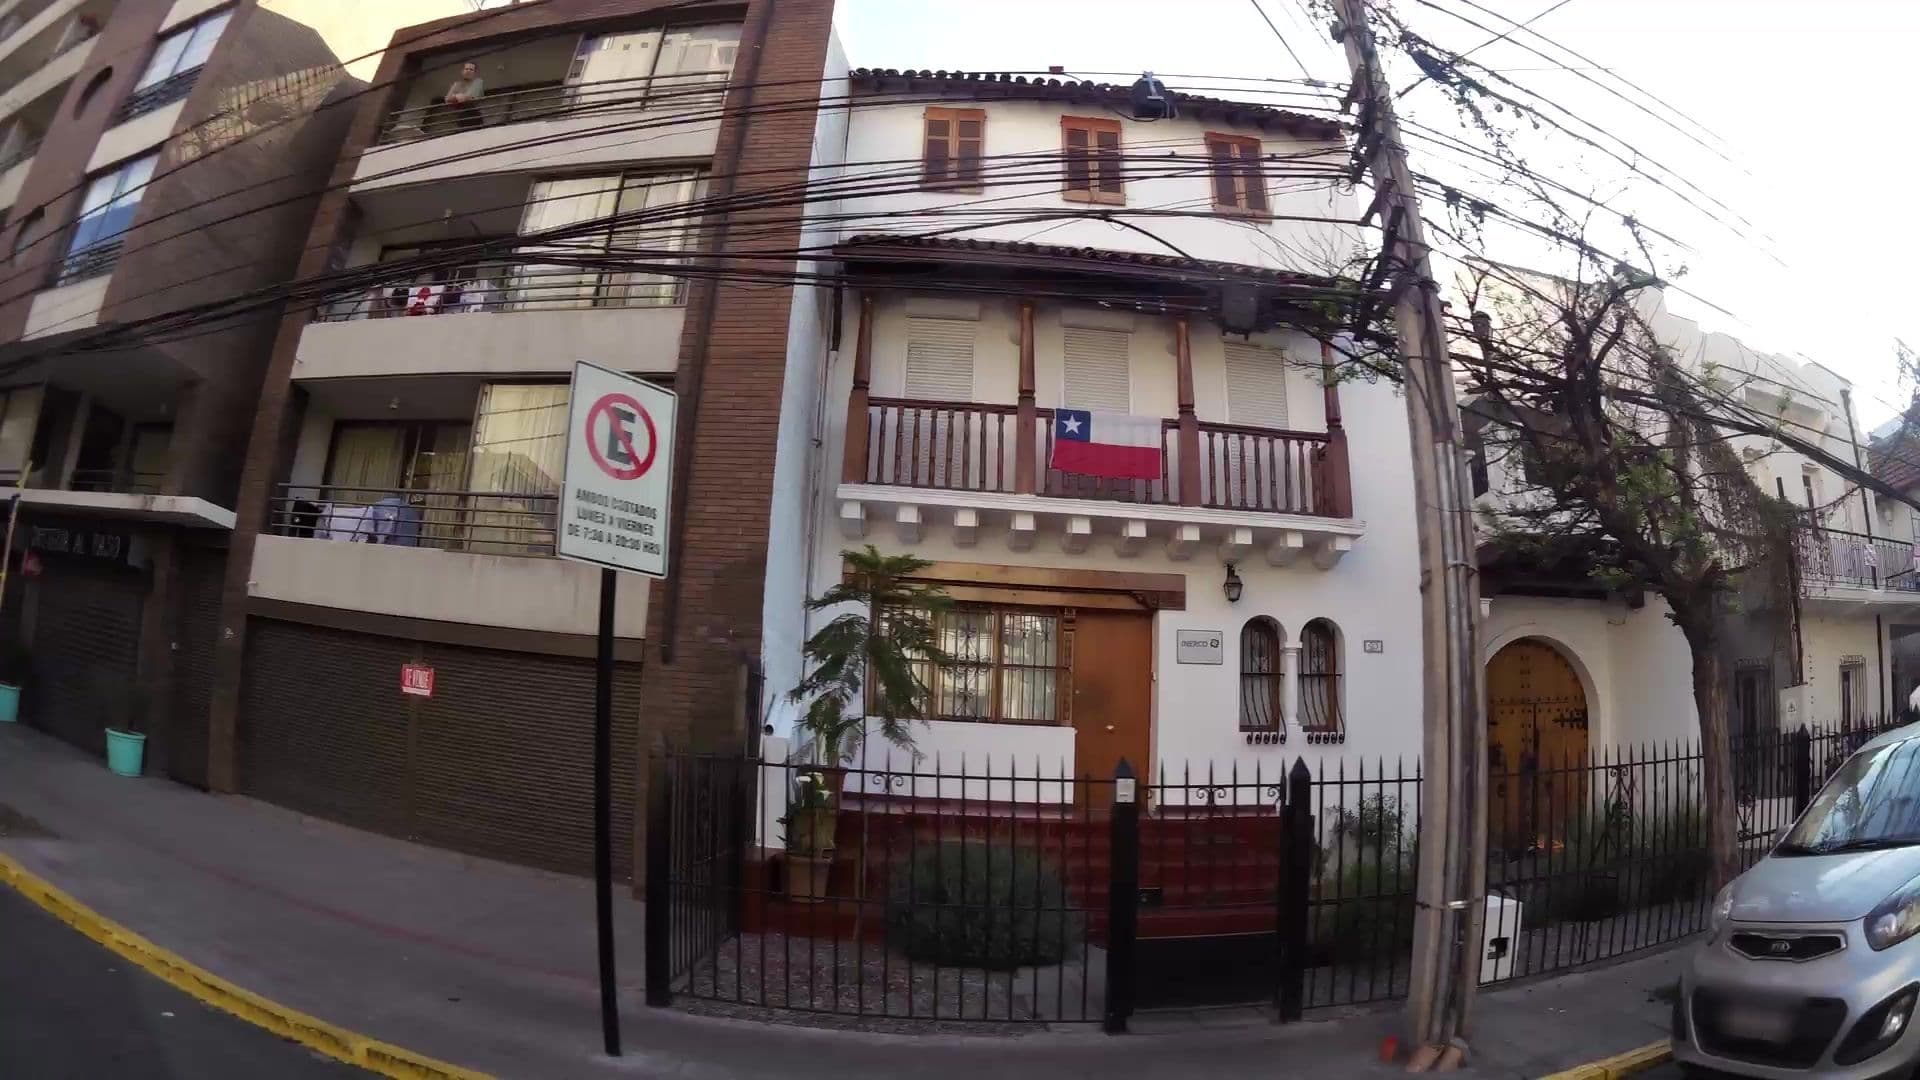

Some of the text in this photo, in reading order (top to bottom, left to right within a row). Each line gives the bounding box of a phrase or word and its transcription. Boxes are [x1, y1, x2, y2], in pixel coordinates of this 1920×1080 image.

[607, 406, 637, 466] E
[611, 497, 657, 520] COSTADOS
[577, 506, 606, 525] LUNES
[615, 516, 654, 536] VIERNES
[567, 522, 581, 537] DE
[605, 532, 613, 544] A
[413, 670, 430, 688] VENDE
